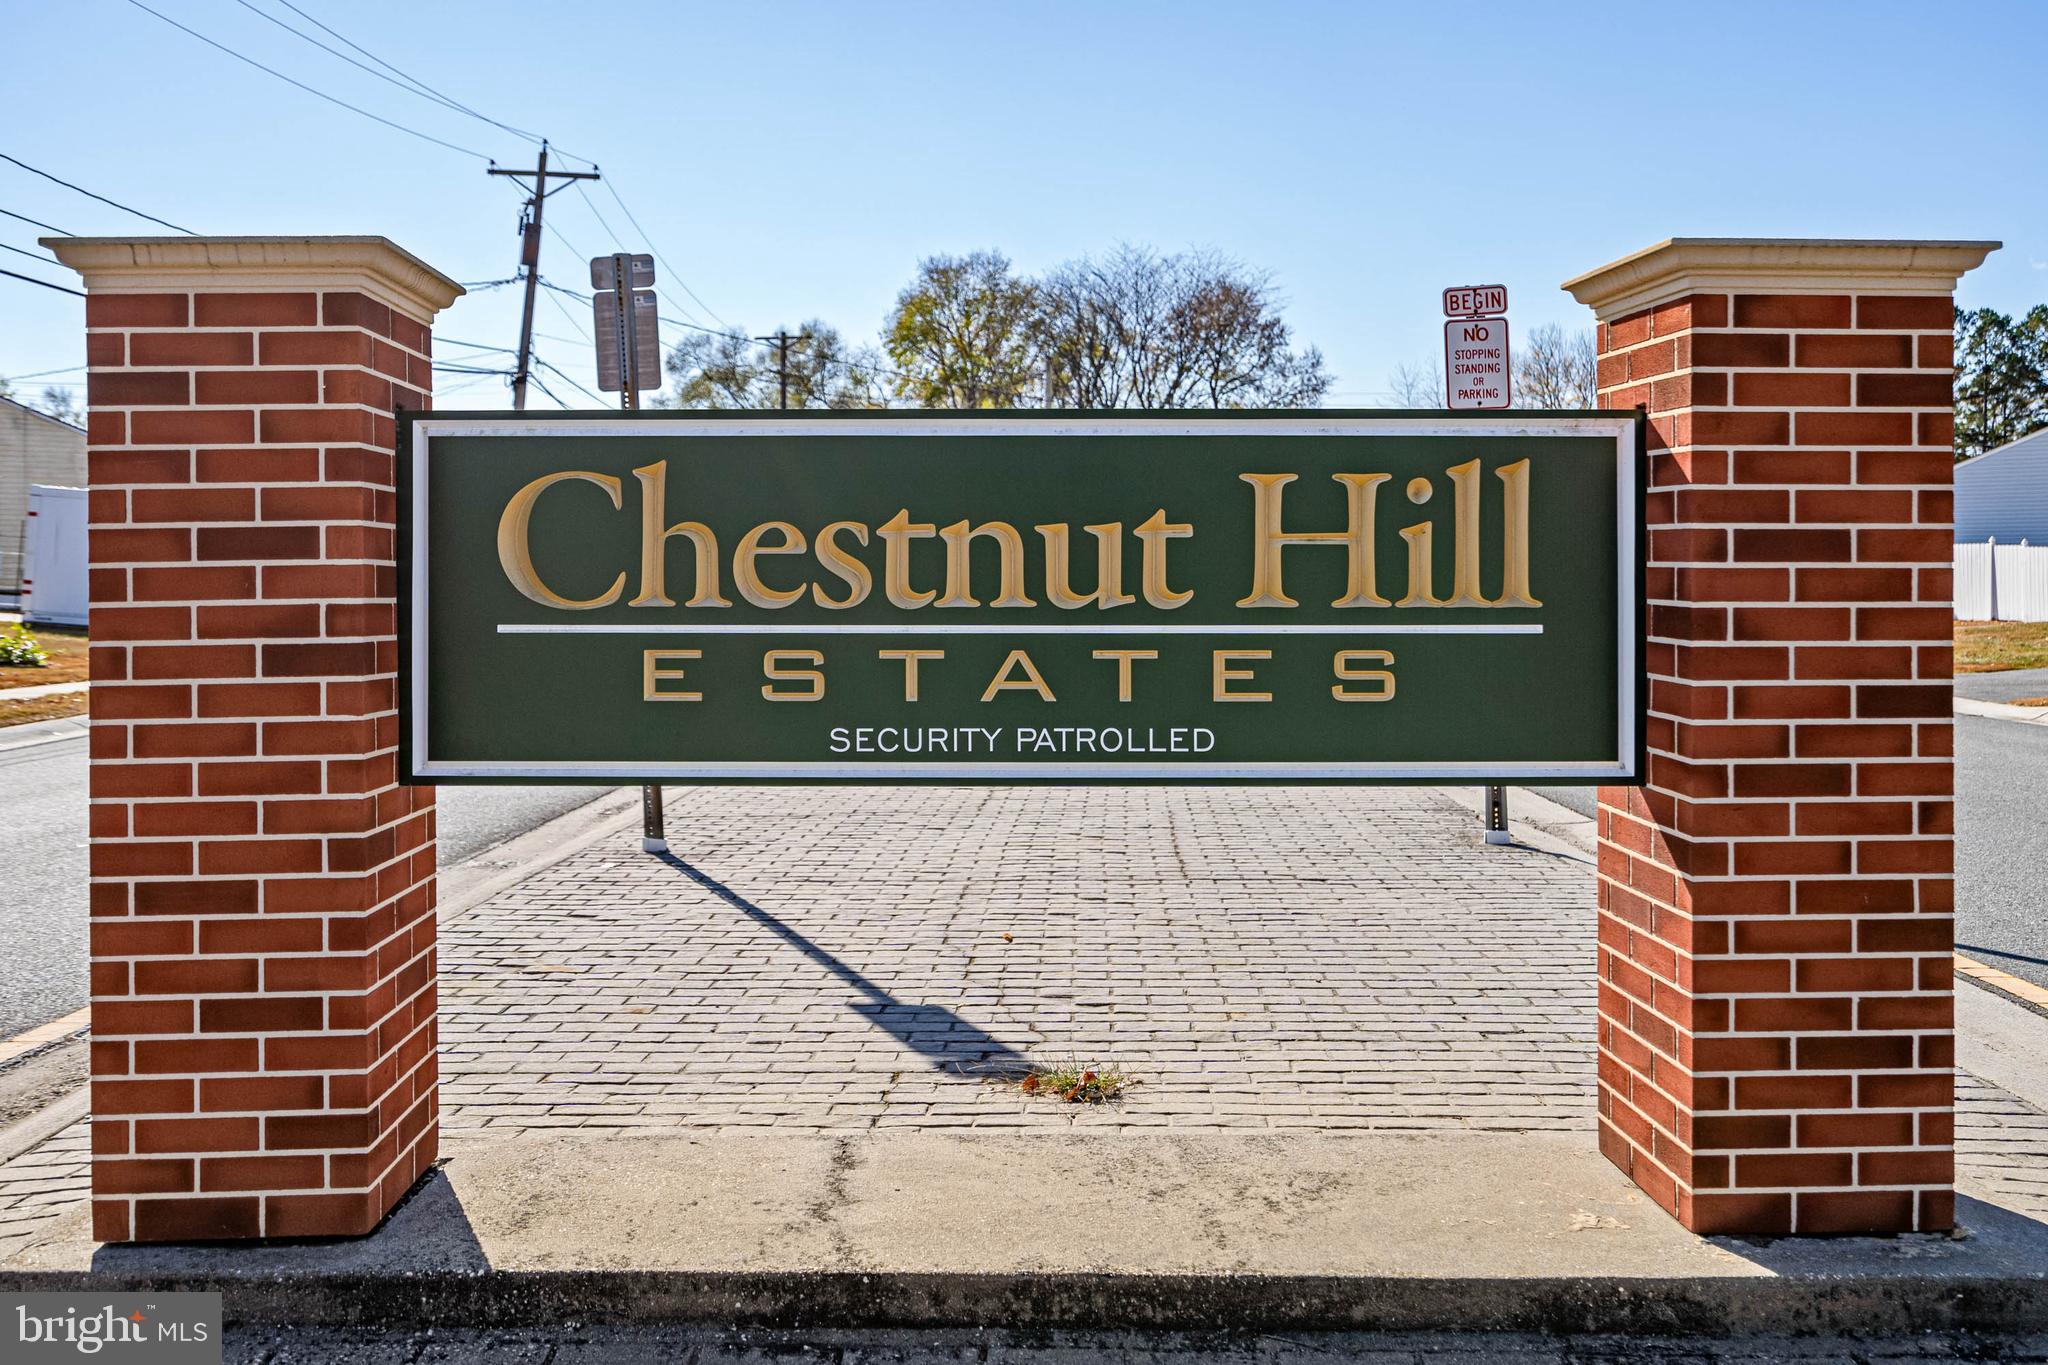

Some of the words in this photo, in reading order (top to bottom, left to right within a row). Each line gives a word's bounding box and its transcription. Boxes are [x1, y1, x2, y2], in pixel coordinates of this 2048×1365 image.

[1449, 291, 1502, 311] BEGIN
[1463, 327, 1489, 342] NO
[1455, 348, 1501, 361] STOPPING
[1455, 363, 1501, 375] STANDING
[1472, 377, 1485, 386] OR
[1458, 388, 1499, 400] PARKING
[497, 459, 1194, 610] Chestnut
[1236, 458, 1543, 609] Hill
[642, 649, 1397, 702] ESTATES
[829, 727, 1004, 753] SECURITY
[1016, 728, 1215, 753] PATROLLED
